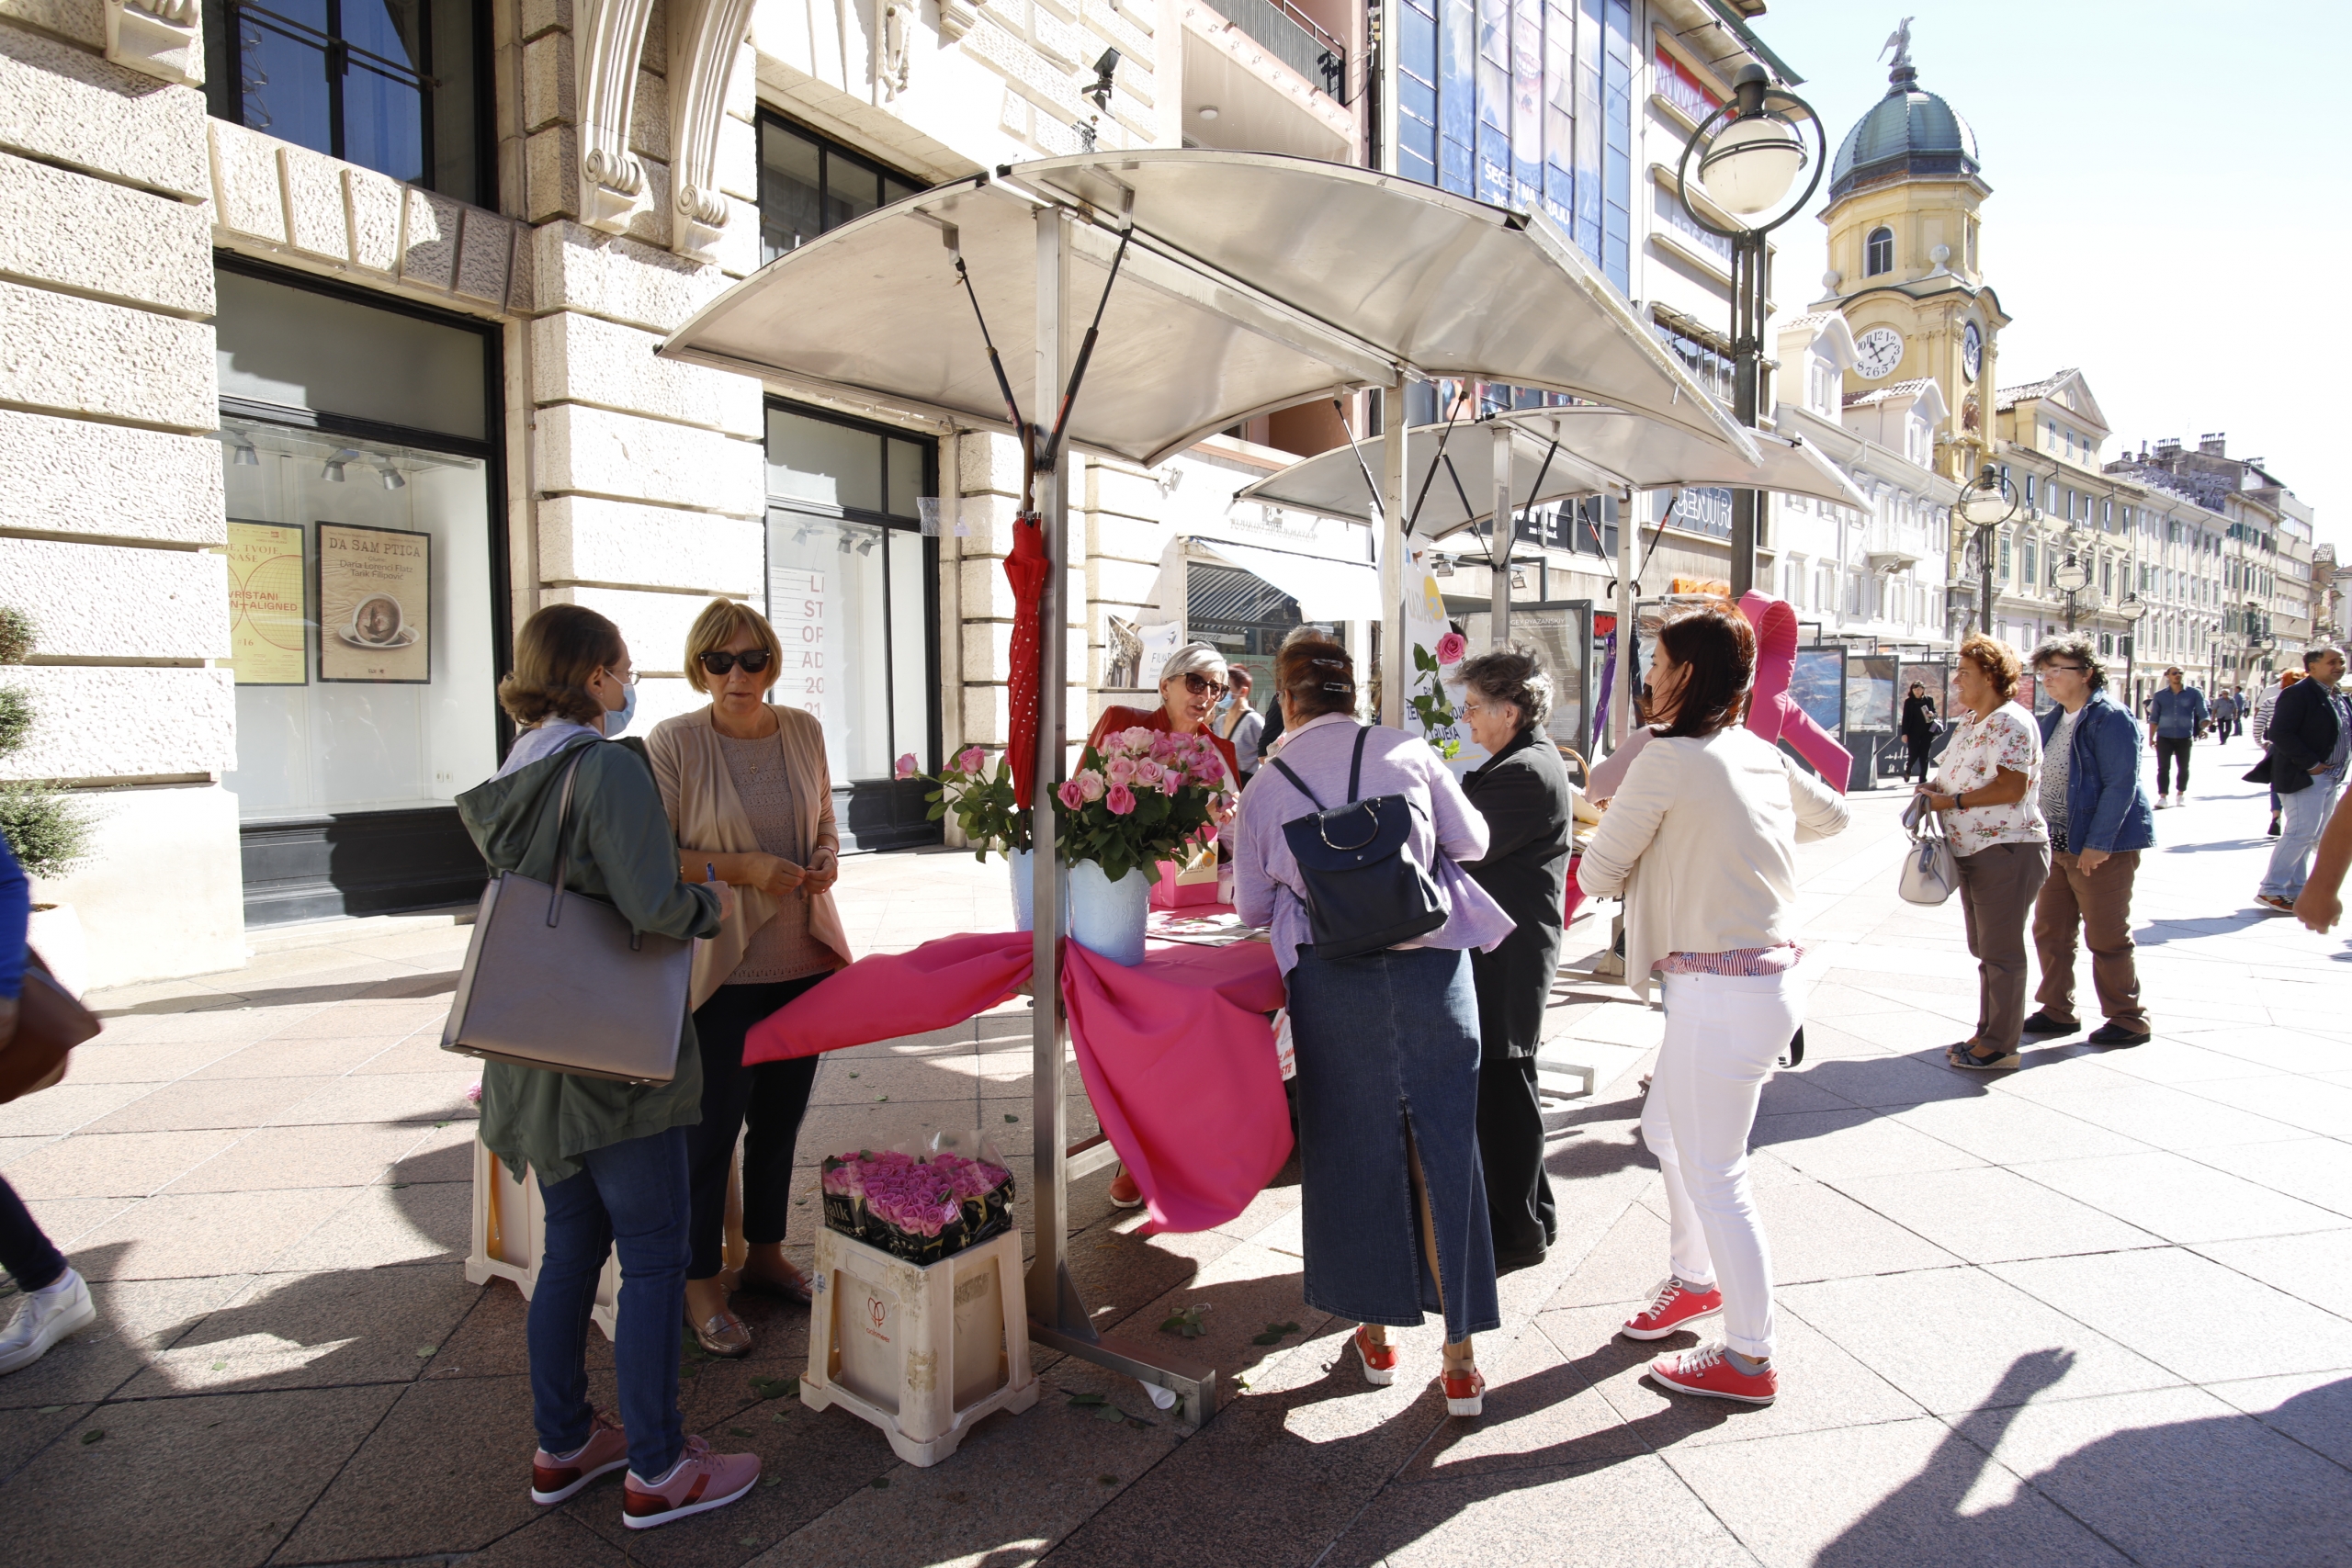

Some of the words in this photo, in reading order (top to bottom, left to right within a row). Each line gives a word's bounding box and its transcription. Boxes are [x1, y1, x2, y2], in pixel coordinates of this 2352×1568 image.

[1672, 487, 1732, 529] CENTR
[329, 537, 347, 550] DA
[352, 539, 379, 554] SAM
[383, 543, 421, 558] PTICA
[228, 552, 258, 563] NAŠE
[339, 559, 362, 569] Daria
[364, 561, 393, 571] Lorenci
[395, 564, 413, 573] Flatz
[350, 569, 368, 578] Tarik
[371, 570, 404, 581] Filipović
[229, 600, 298, 612] N-ALIGNED
[804, 599, 824, 618] ST
[237, 637, 254, 647] #16
[801, 651, 824, 669] AD
[805, 676, 824, 694] 20
